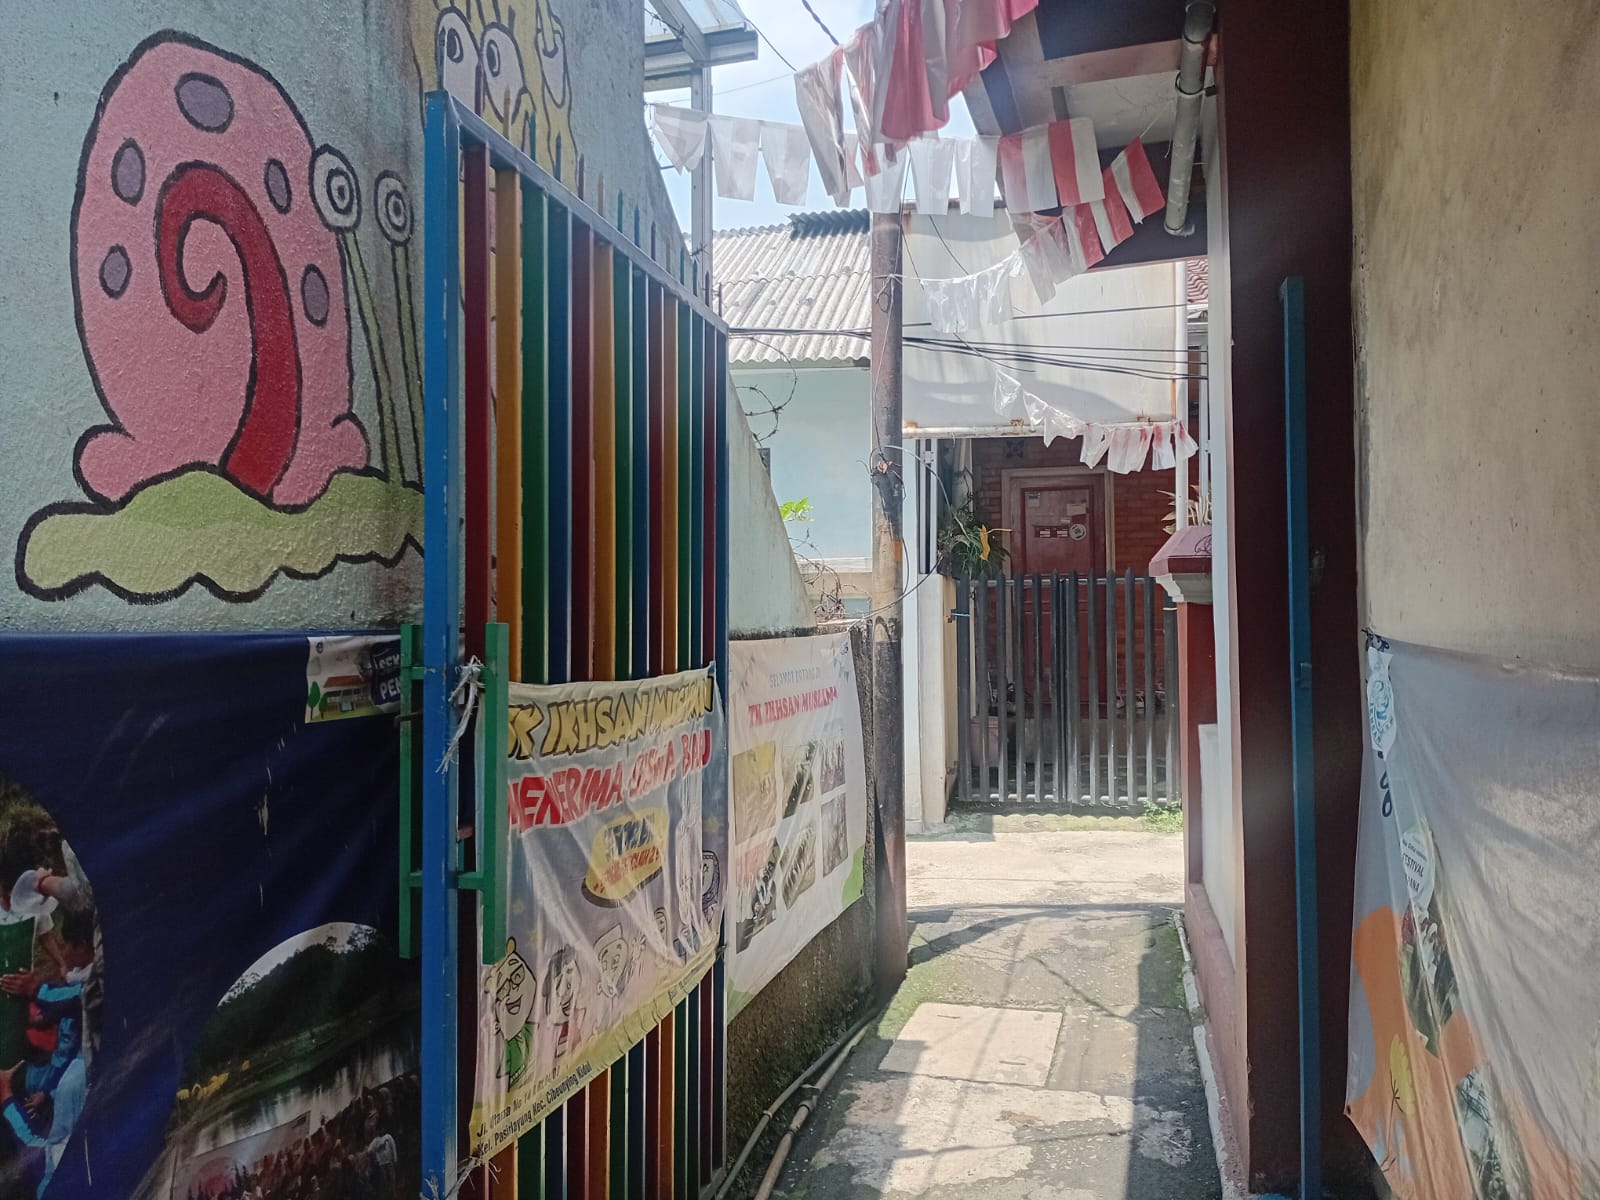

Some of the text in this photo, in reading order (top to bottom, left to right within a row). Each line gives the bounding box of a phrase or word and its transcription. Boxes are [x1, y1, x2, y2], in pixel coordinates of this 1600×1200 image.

[541, 690, 649, 756] IKHSAN
[764, 694, 800, 722] IKHSAN
[494, 1110, 532, 1146] Pasirlayung
[532, 1101, 547, 1119] Kec.
[546, 1073, 579, 1104] Cibeunying
[576, 1061, 592, 1078] Kidul
